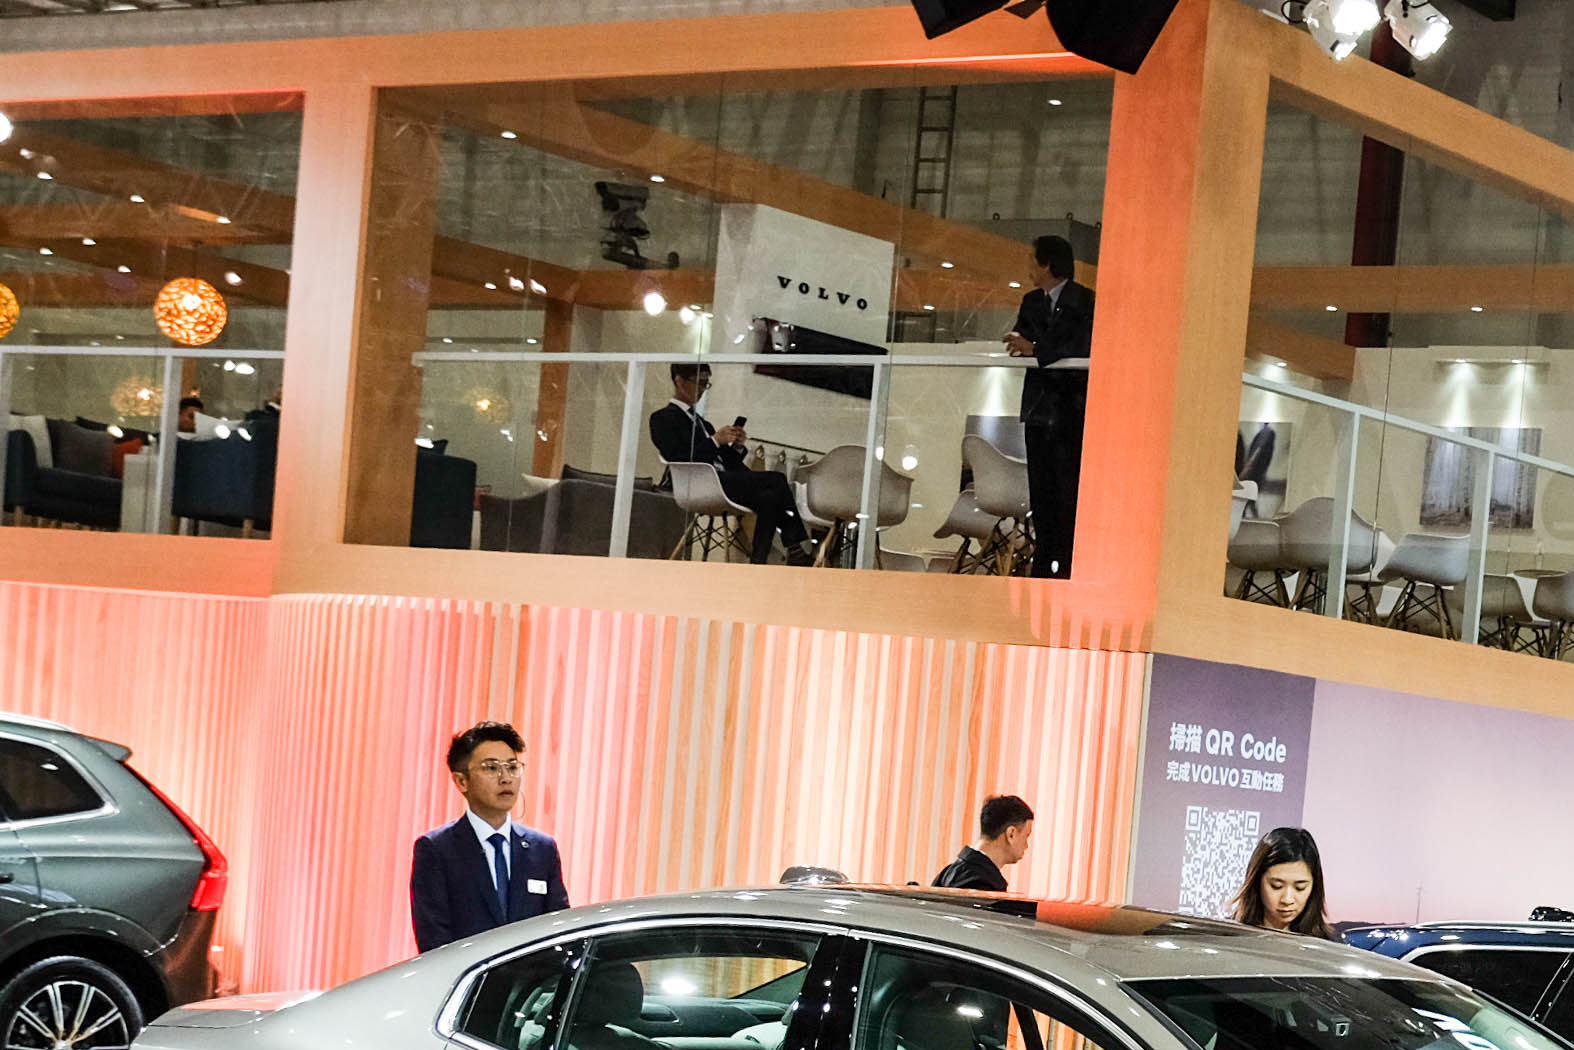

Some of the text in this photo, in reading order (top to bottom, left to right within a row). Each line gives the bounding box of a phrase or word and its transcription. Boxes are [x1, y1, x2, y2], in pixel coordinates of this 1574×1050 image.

[777, 275, 868, 311] VOLVO
[1169, 722, 1287, 762] 掃描 QR Code
